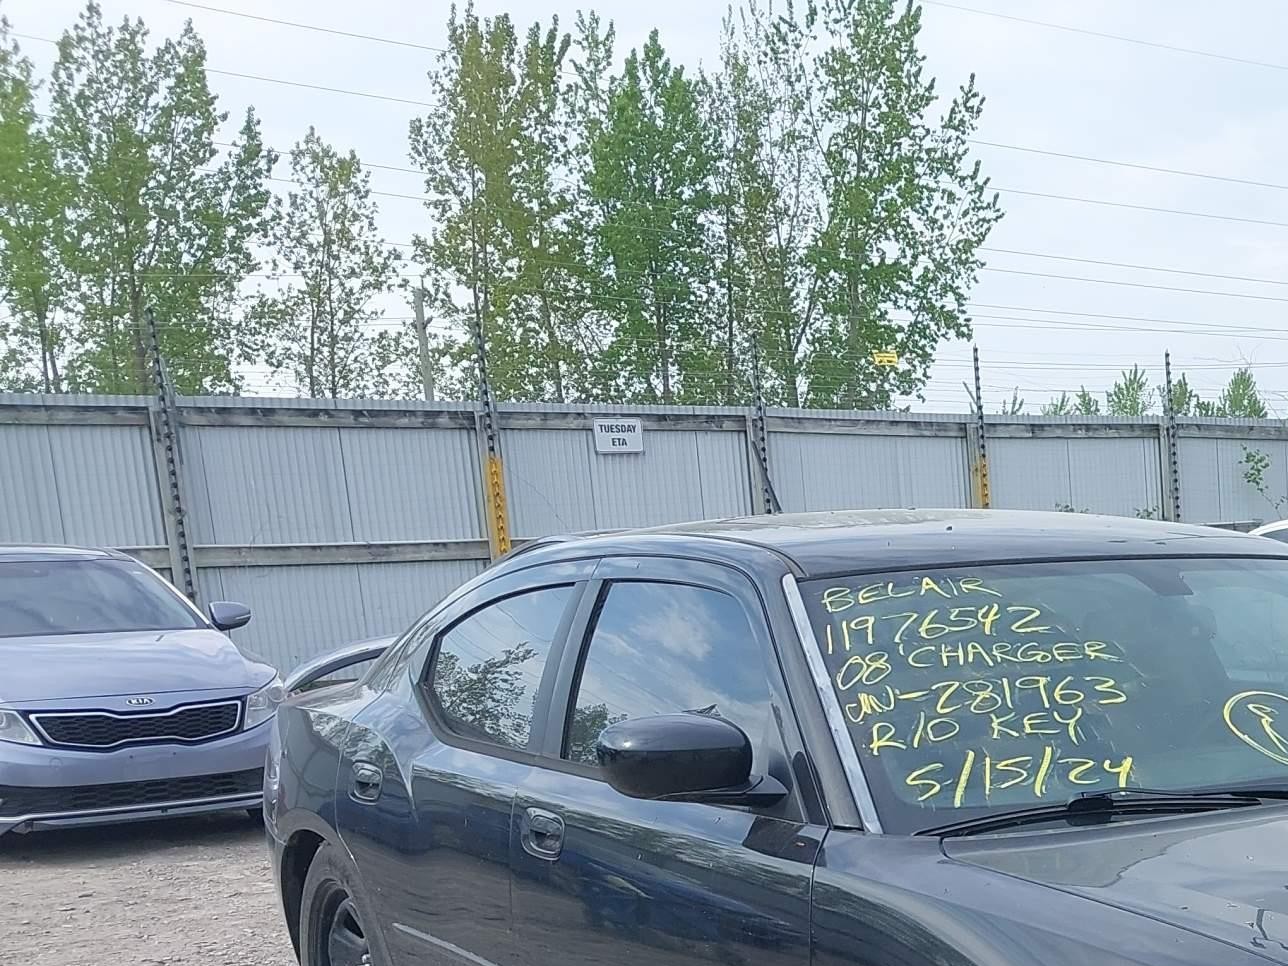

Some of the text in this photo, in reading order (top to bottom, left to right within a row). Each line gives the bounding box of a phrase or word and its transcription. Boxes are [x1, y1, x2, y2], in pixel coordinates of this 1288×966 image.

[598, 424, 636, 433] TUESDAY
[611, 437, 627, 446] ETA
[826, 603, 1052, 655] 11976542
[990, 708, 1083, 746] KEY
